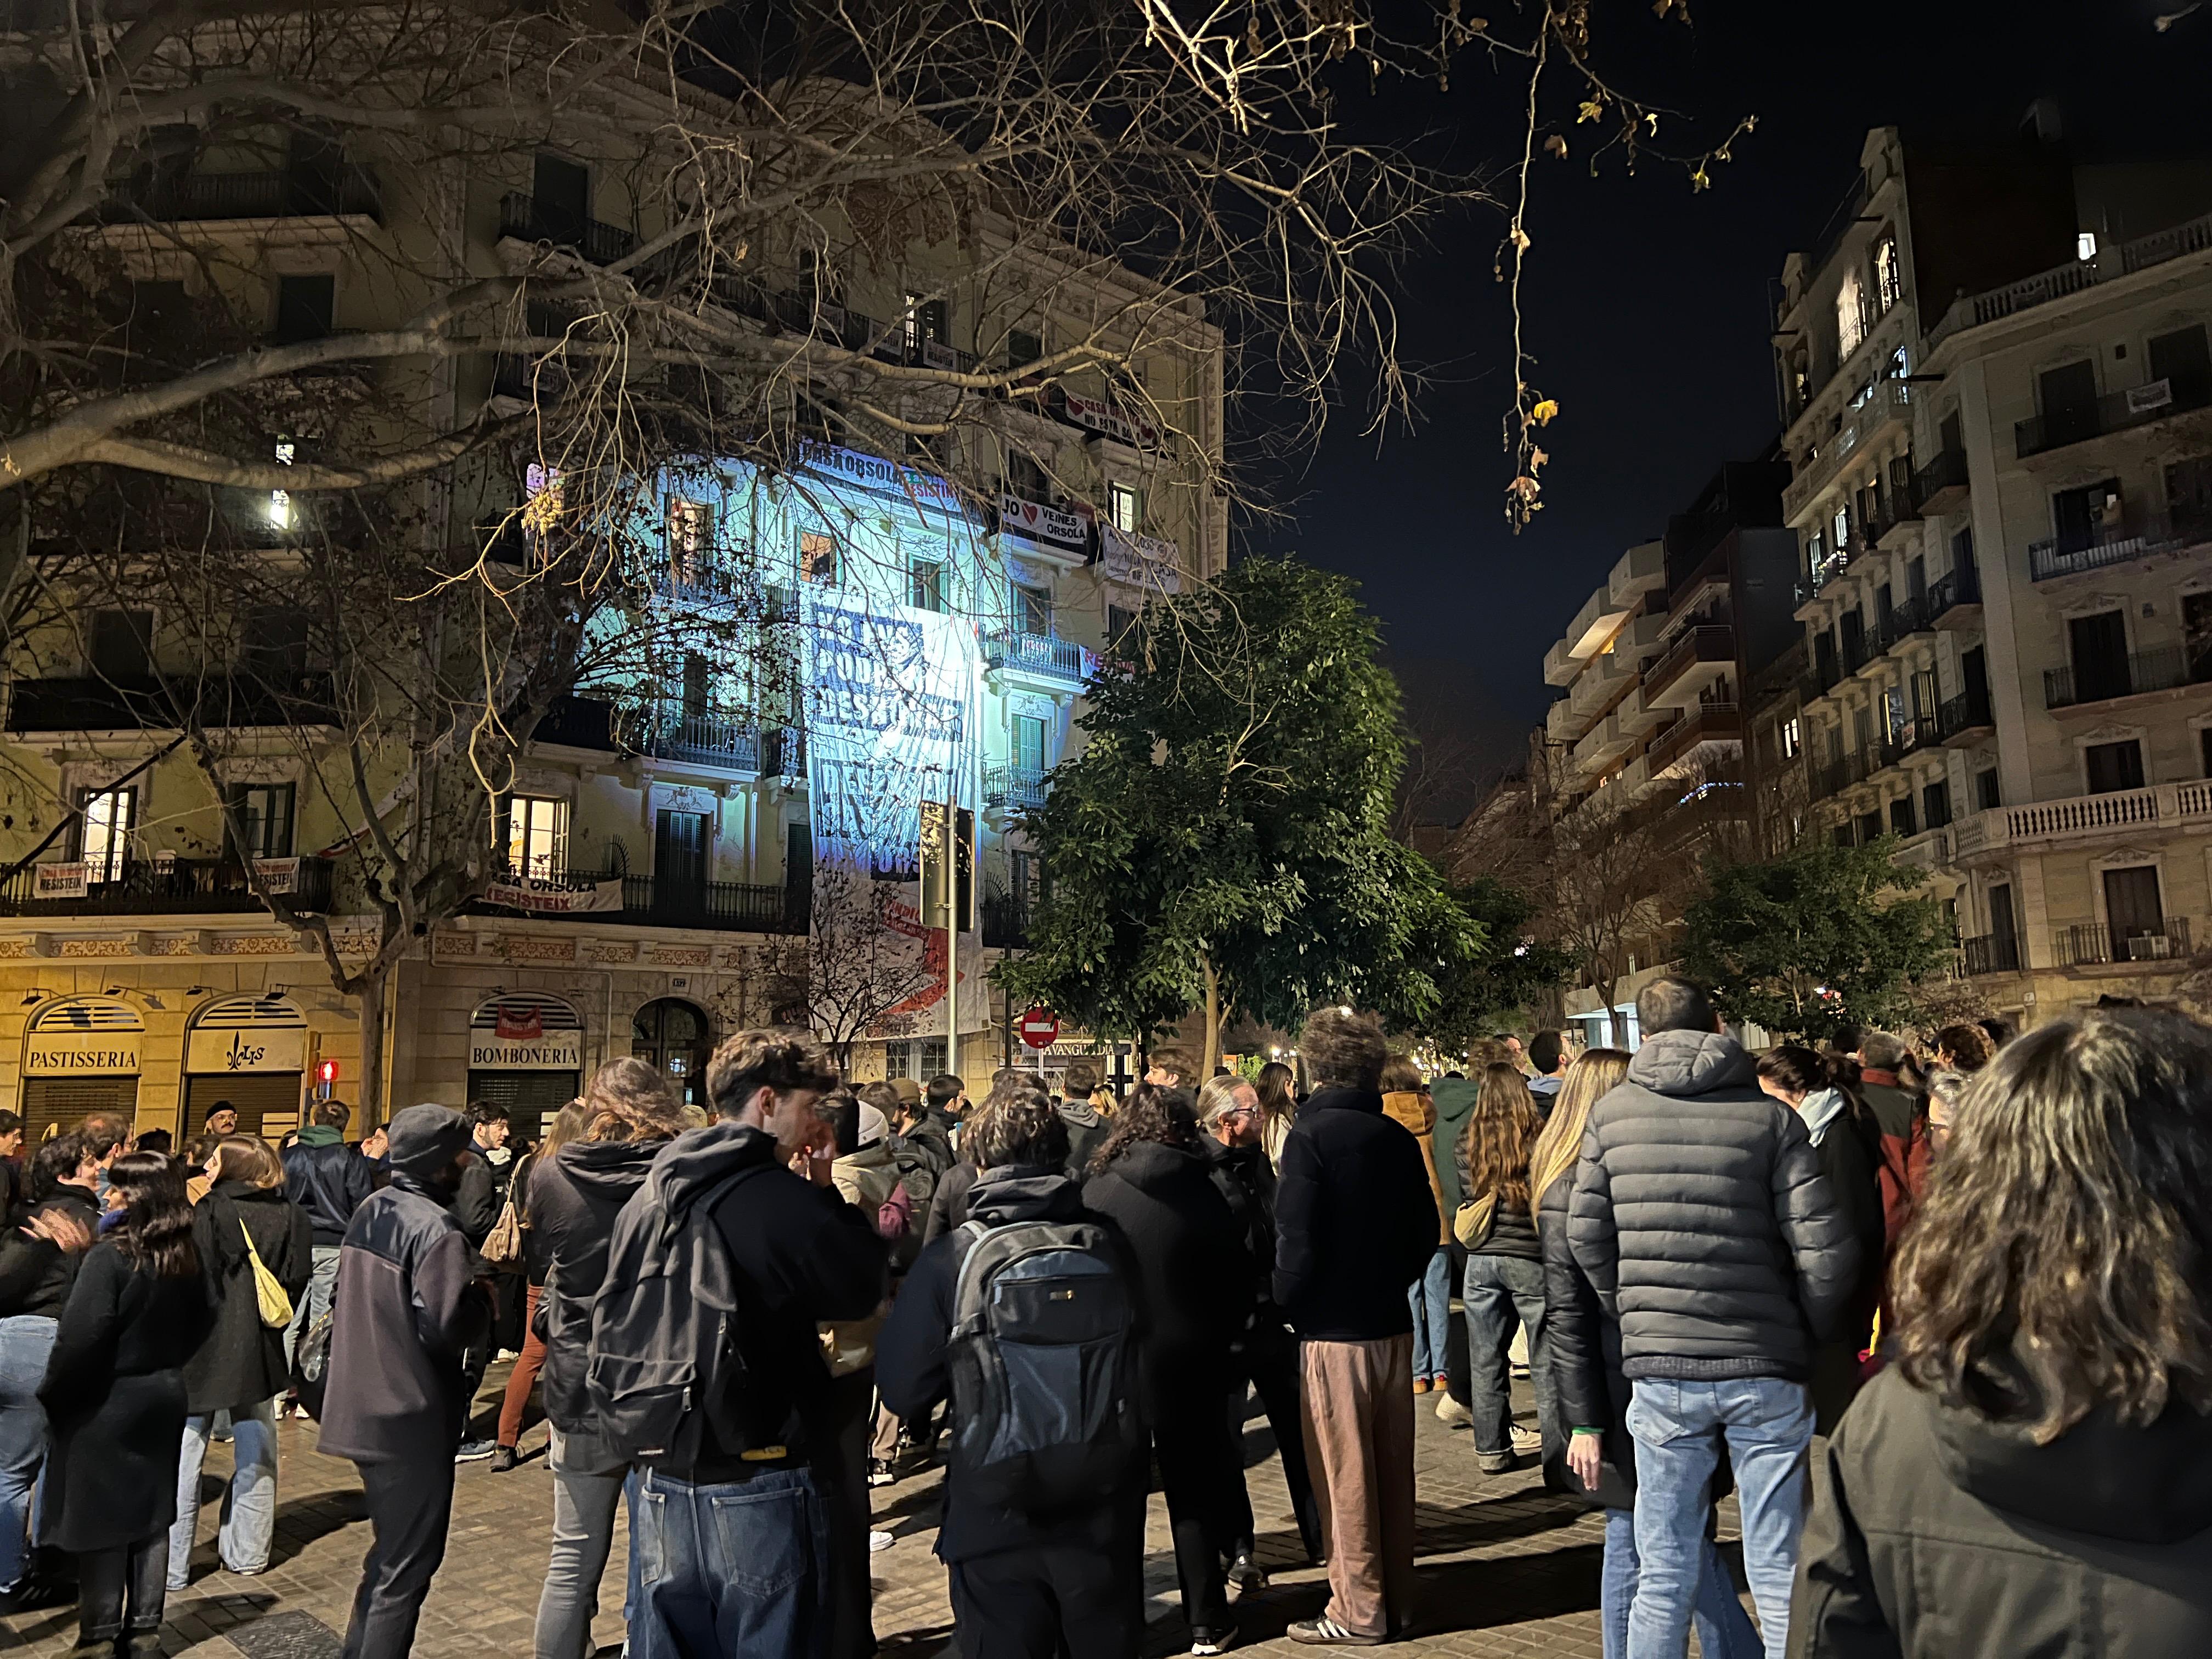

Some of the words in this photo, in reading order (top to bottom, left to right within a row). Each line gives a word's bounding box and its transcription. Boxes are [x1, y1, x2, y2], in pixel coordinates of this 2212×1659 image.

[1085, 399, 1107, 415] CASA
[1084, 414, 1096, 426] NO
[1002, 499, 1019, 516] JO
[1047, 523, 1086, 539] ORSOLA
[40, 877, 81, 890] RESISTEIX
[242, 1045, 266, 1065] LIS
[473, 1048, 577, 1063] BOMBONERIA
[1052, 1043, 1115, 1056] VANGUDIA
[30, 1052, 136, 1068] PASTISSERIA
